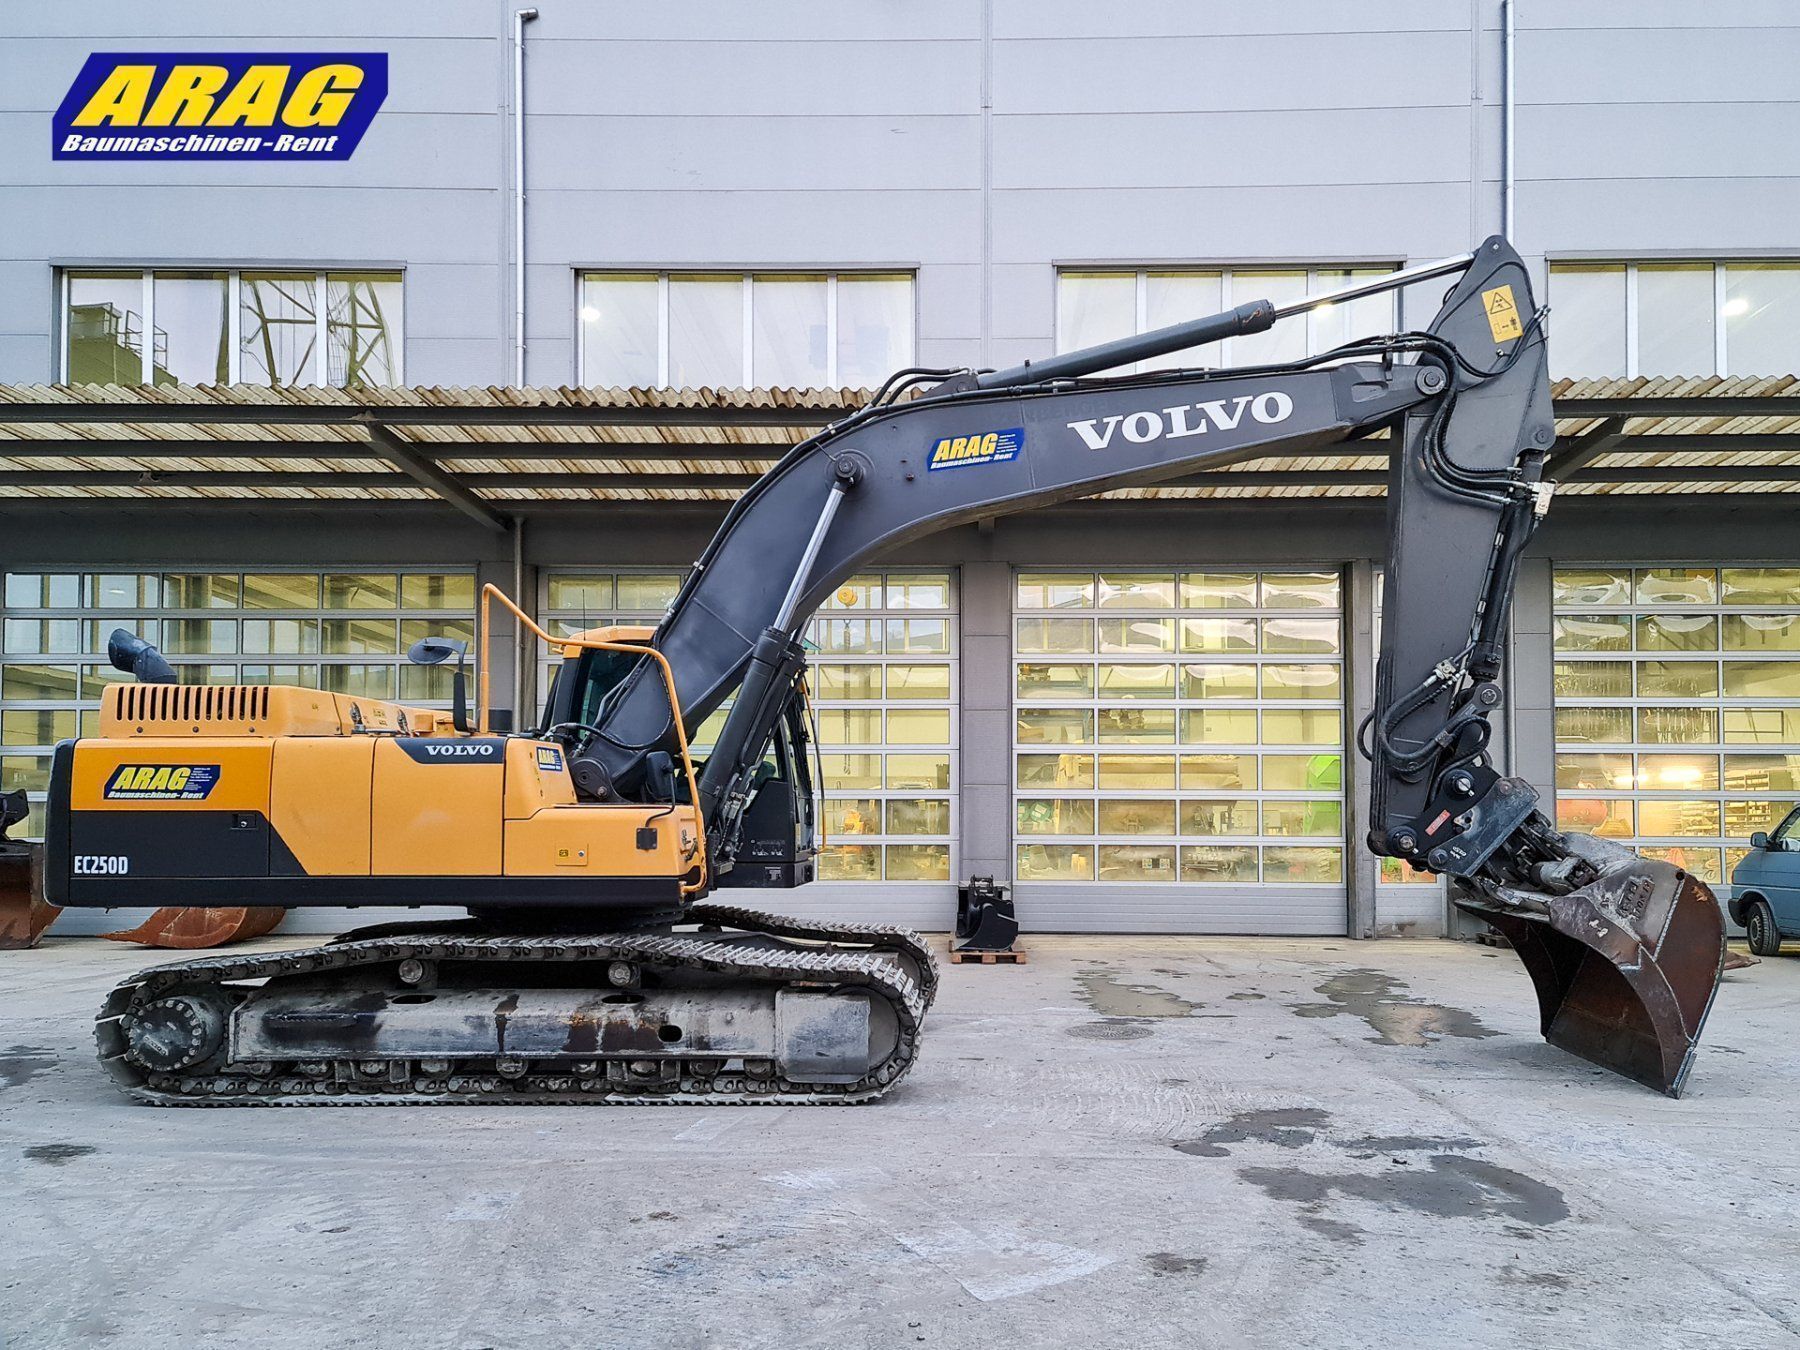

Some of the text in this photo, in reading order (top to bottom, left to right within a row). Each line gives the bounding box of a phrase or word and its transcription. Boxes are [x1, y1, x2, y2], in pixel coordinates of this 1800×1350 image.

[1066, 391, 1294, 450] VOLVO
[932, 432, 999, 462] ARAG
[424, 744, 494, 756] VOLVO
[111, 767, 192, 791] ARAG
[74, 855, 129, 875] EC250D
